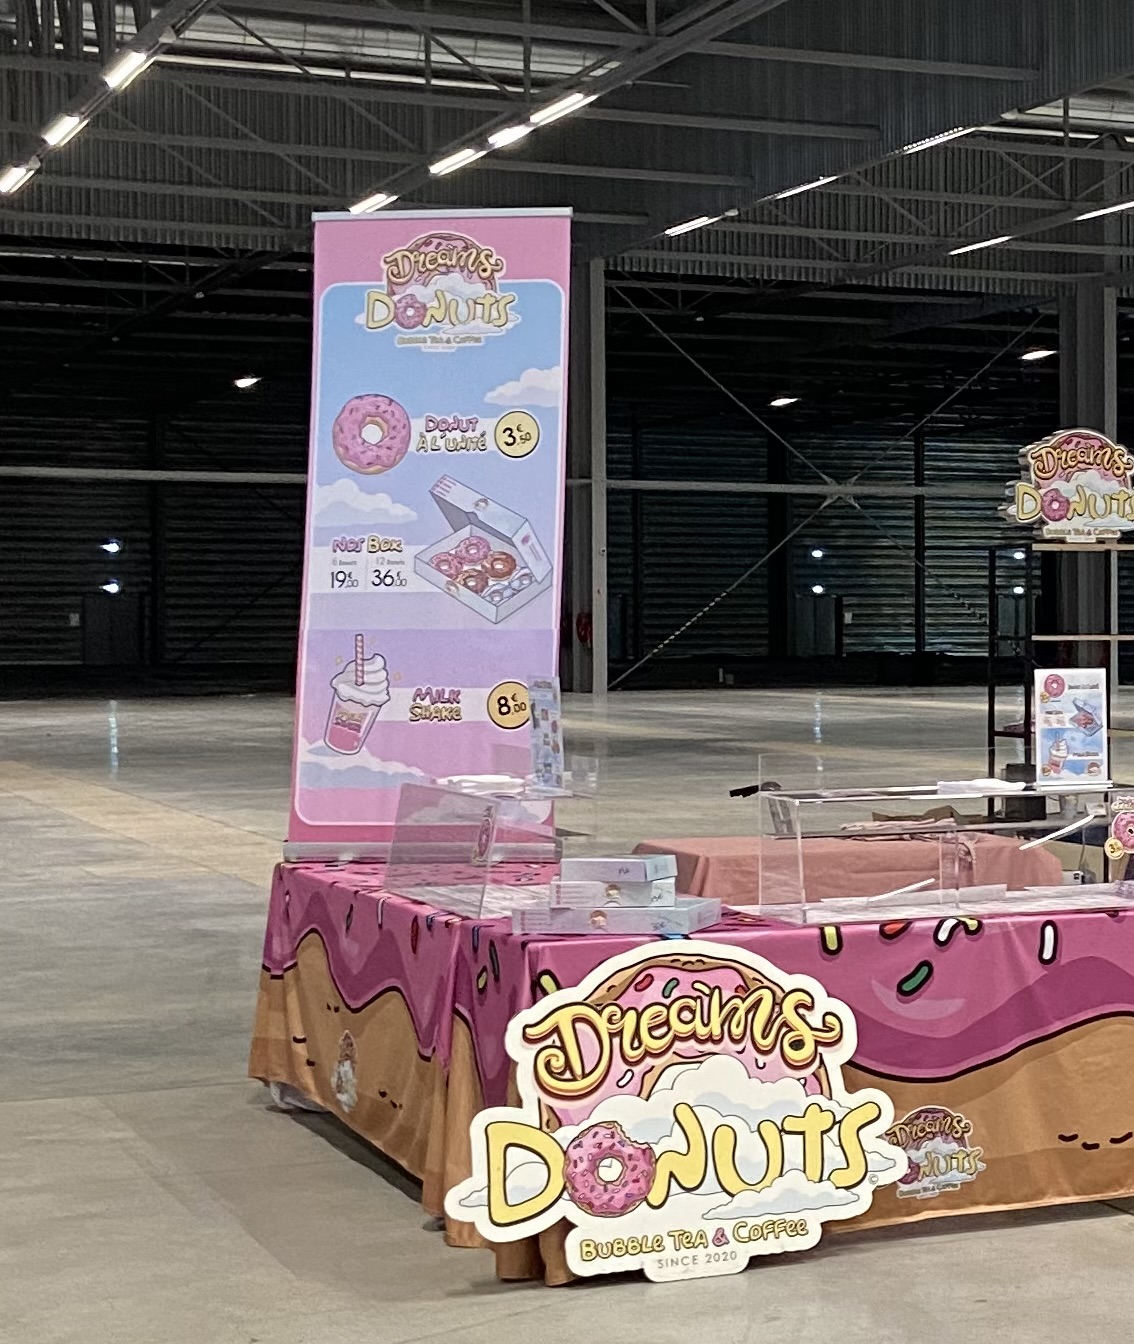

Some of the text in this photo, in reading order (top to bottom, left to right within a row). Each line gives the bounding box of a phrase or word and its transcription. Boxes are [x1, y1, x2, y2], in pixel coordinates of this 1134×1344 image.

[383, 247, 503, 285] Dreams
[366, 289, 515, 329] DONUTS
[425, 415, 479, 432] DONUT
[1031, 444, 1133, 480] Dreams
[412, 687, 461, 705] MILK
[523, 985, 843, 1101] Dreams
[885, 1115, 971, 1149] Dreams
[484, 1102, 882, 1227] DONUTS
[712, 1227, 729, 1246] &
[657, 1250, 737, 1269] SINCE 2020
